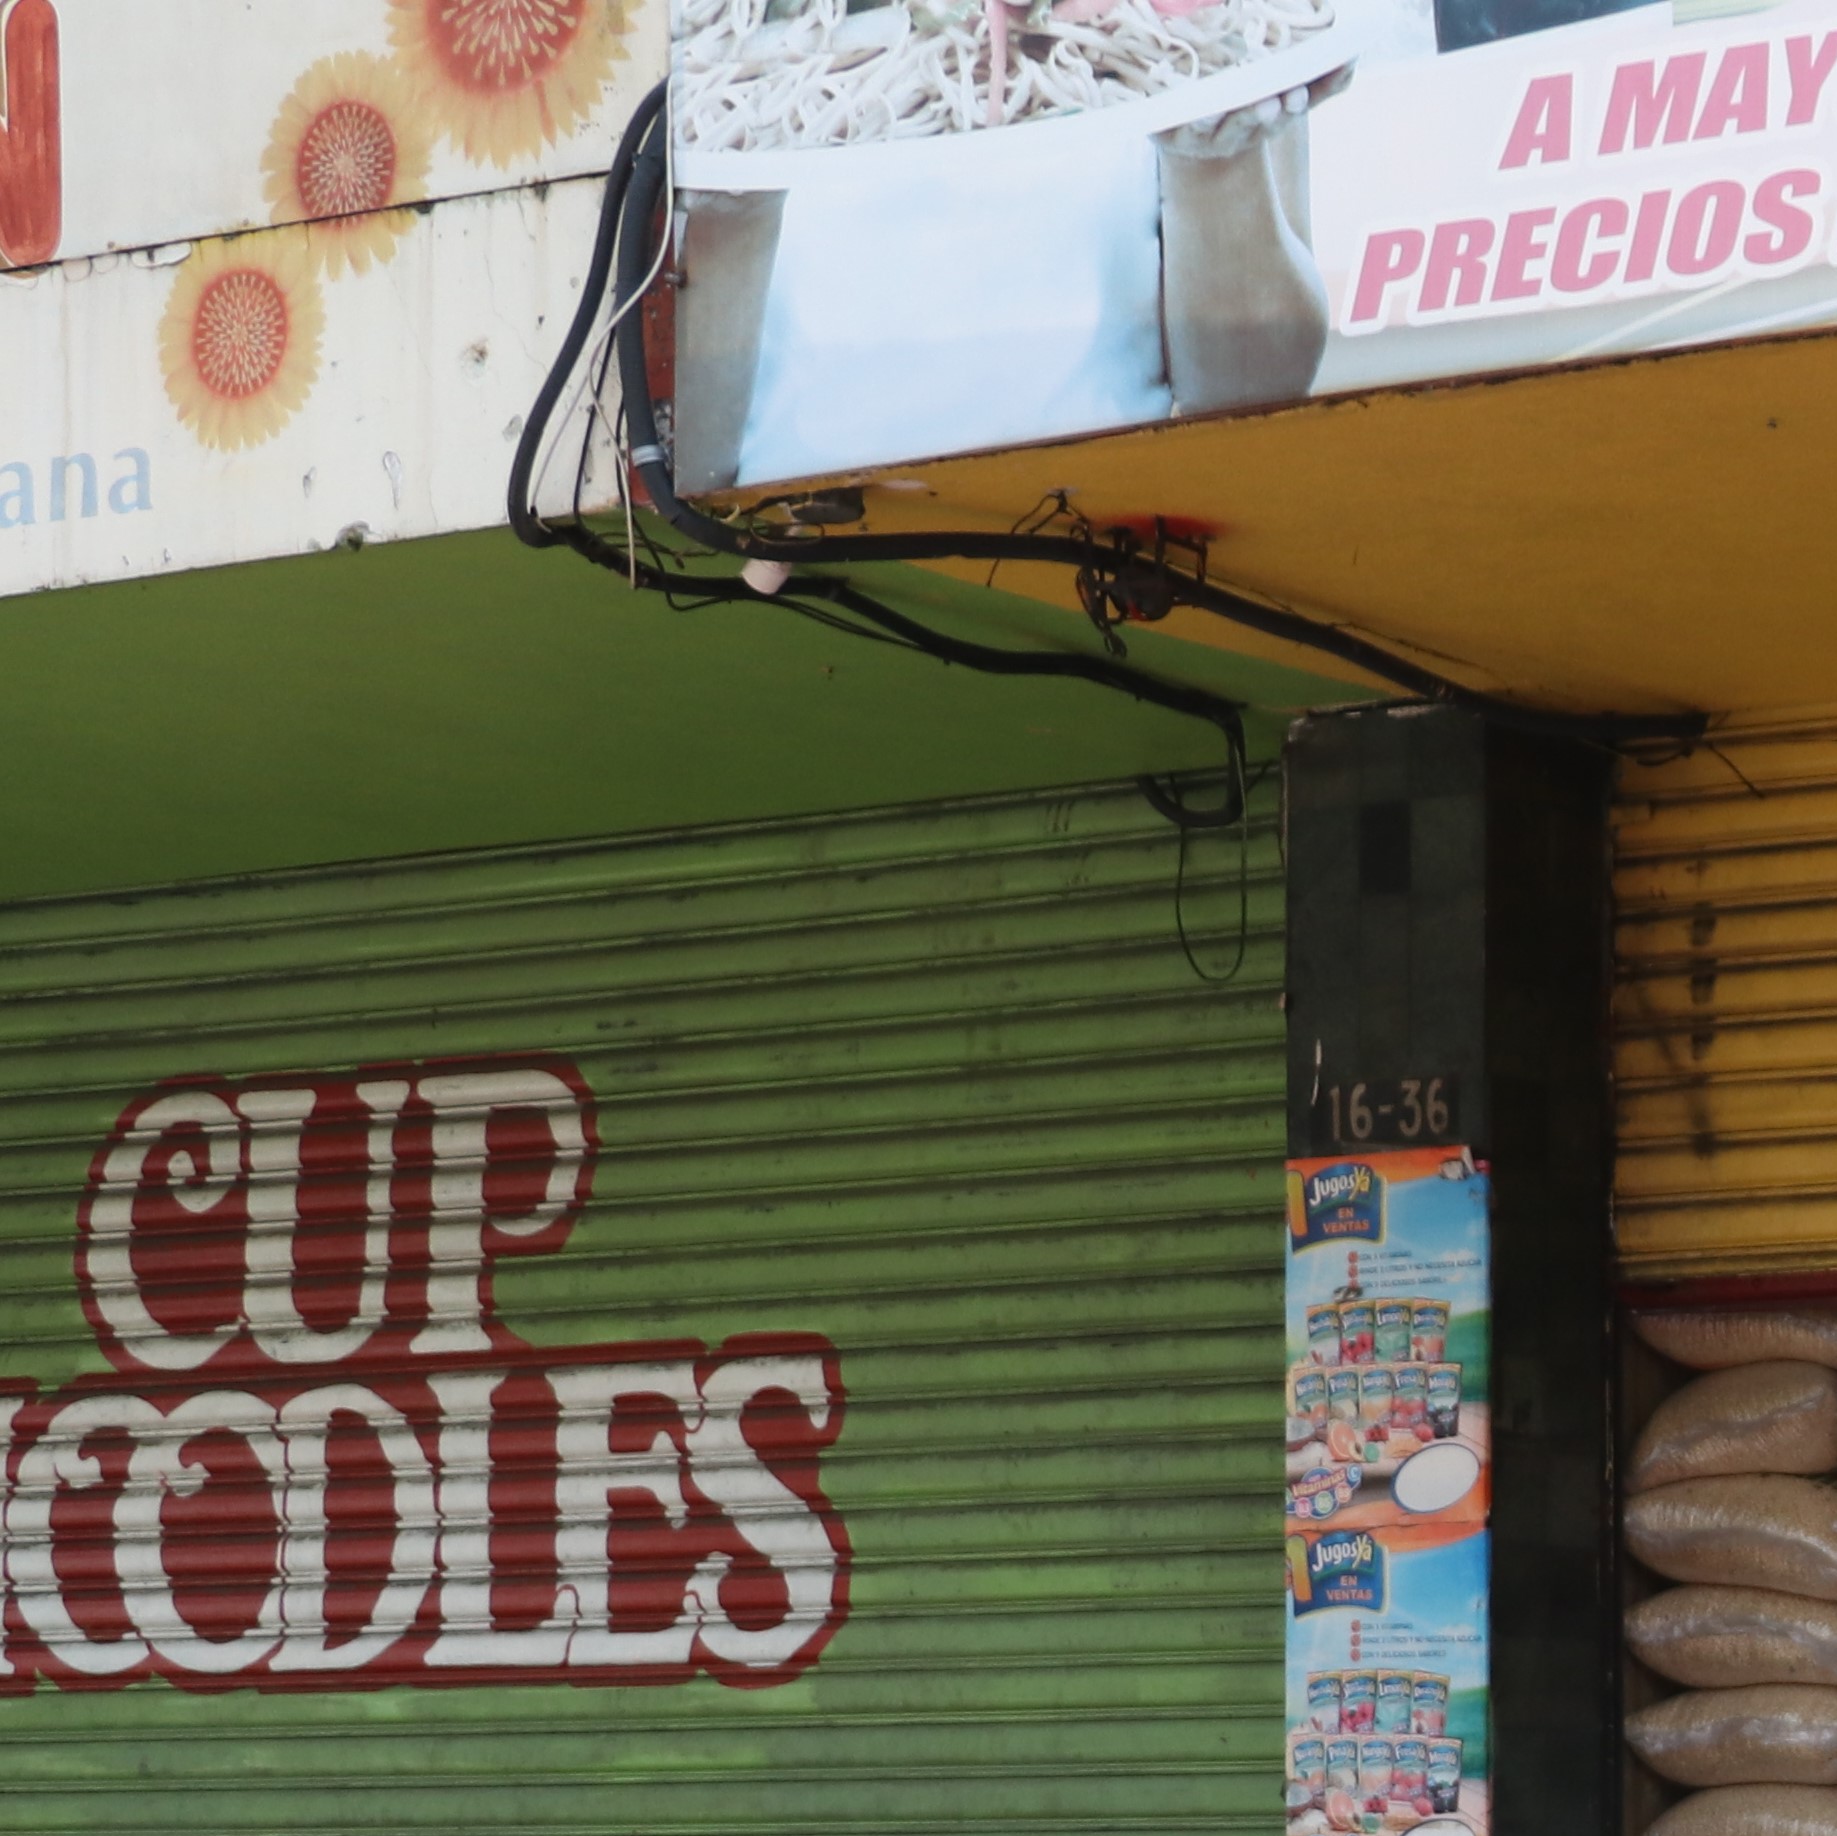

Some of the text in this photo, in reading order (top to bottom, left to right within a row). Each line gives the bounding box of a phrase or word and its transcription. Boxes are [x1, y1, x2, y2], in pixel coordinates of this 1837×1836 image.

[1497, 74, 1573, 172] A
[1350, 168, 1815, 321] PRECIOS
[1328, 1077, 1450, 1141] 16-36
[84, 1066, 590, 1372] CUP
[1322, 1220, 1370, 1234] VENTAS
[1338, 1207, 1355, 1219] EN
[0, 1350, 839, 1676] OODLES
[1325, 1588, 1374, 1601] VENTAS
[1340, 1575, 1358, 1586] EN
